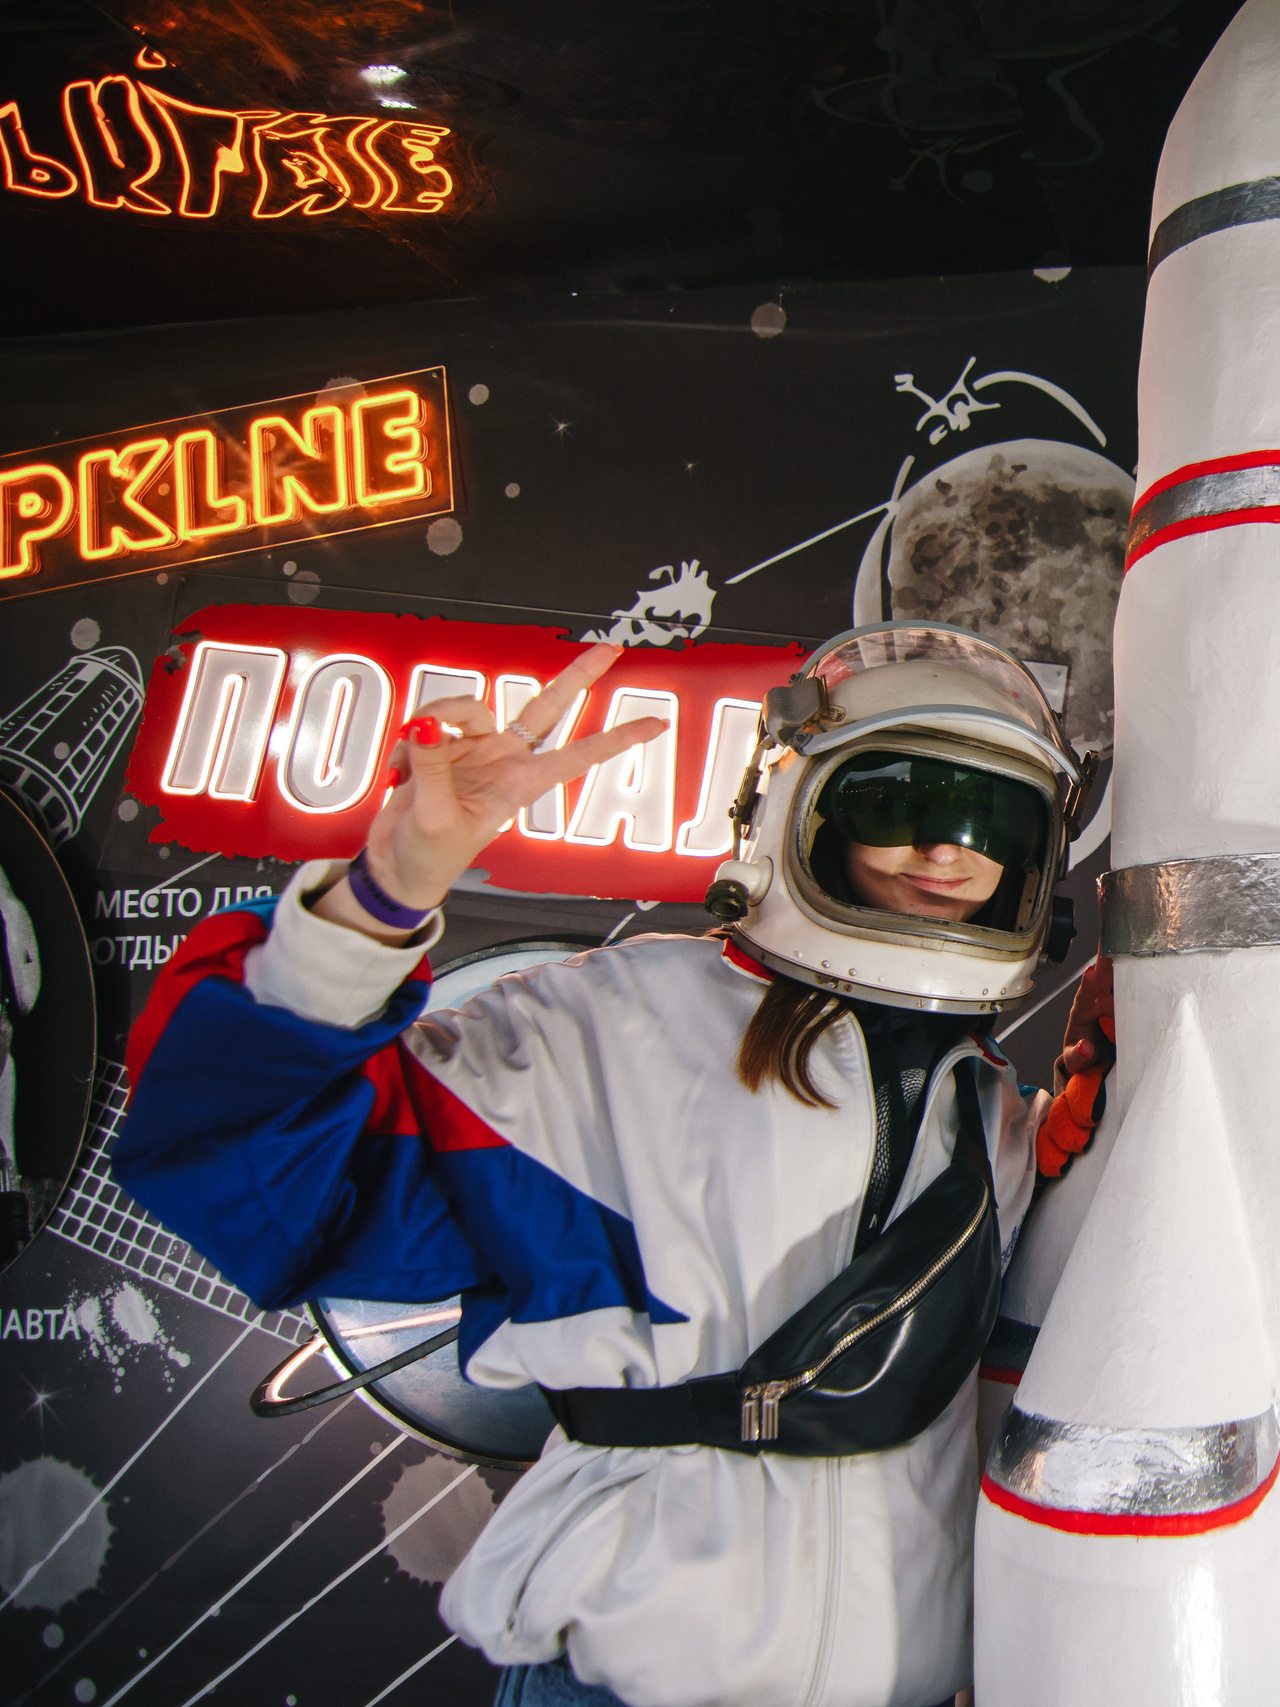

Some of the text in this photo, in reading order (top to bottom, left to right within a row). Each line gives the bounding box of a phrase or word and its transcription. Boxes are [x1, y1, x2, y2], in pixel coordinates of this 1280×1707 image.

[96, 888, 202, 918] МЕСТО
[93, 935, 187, 971] ОТДЫ
[0, 1308, 81, 1340] АВТА
